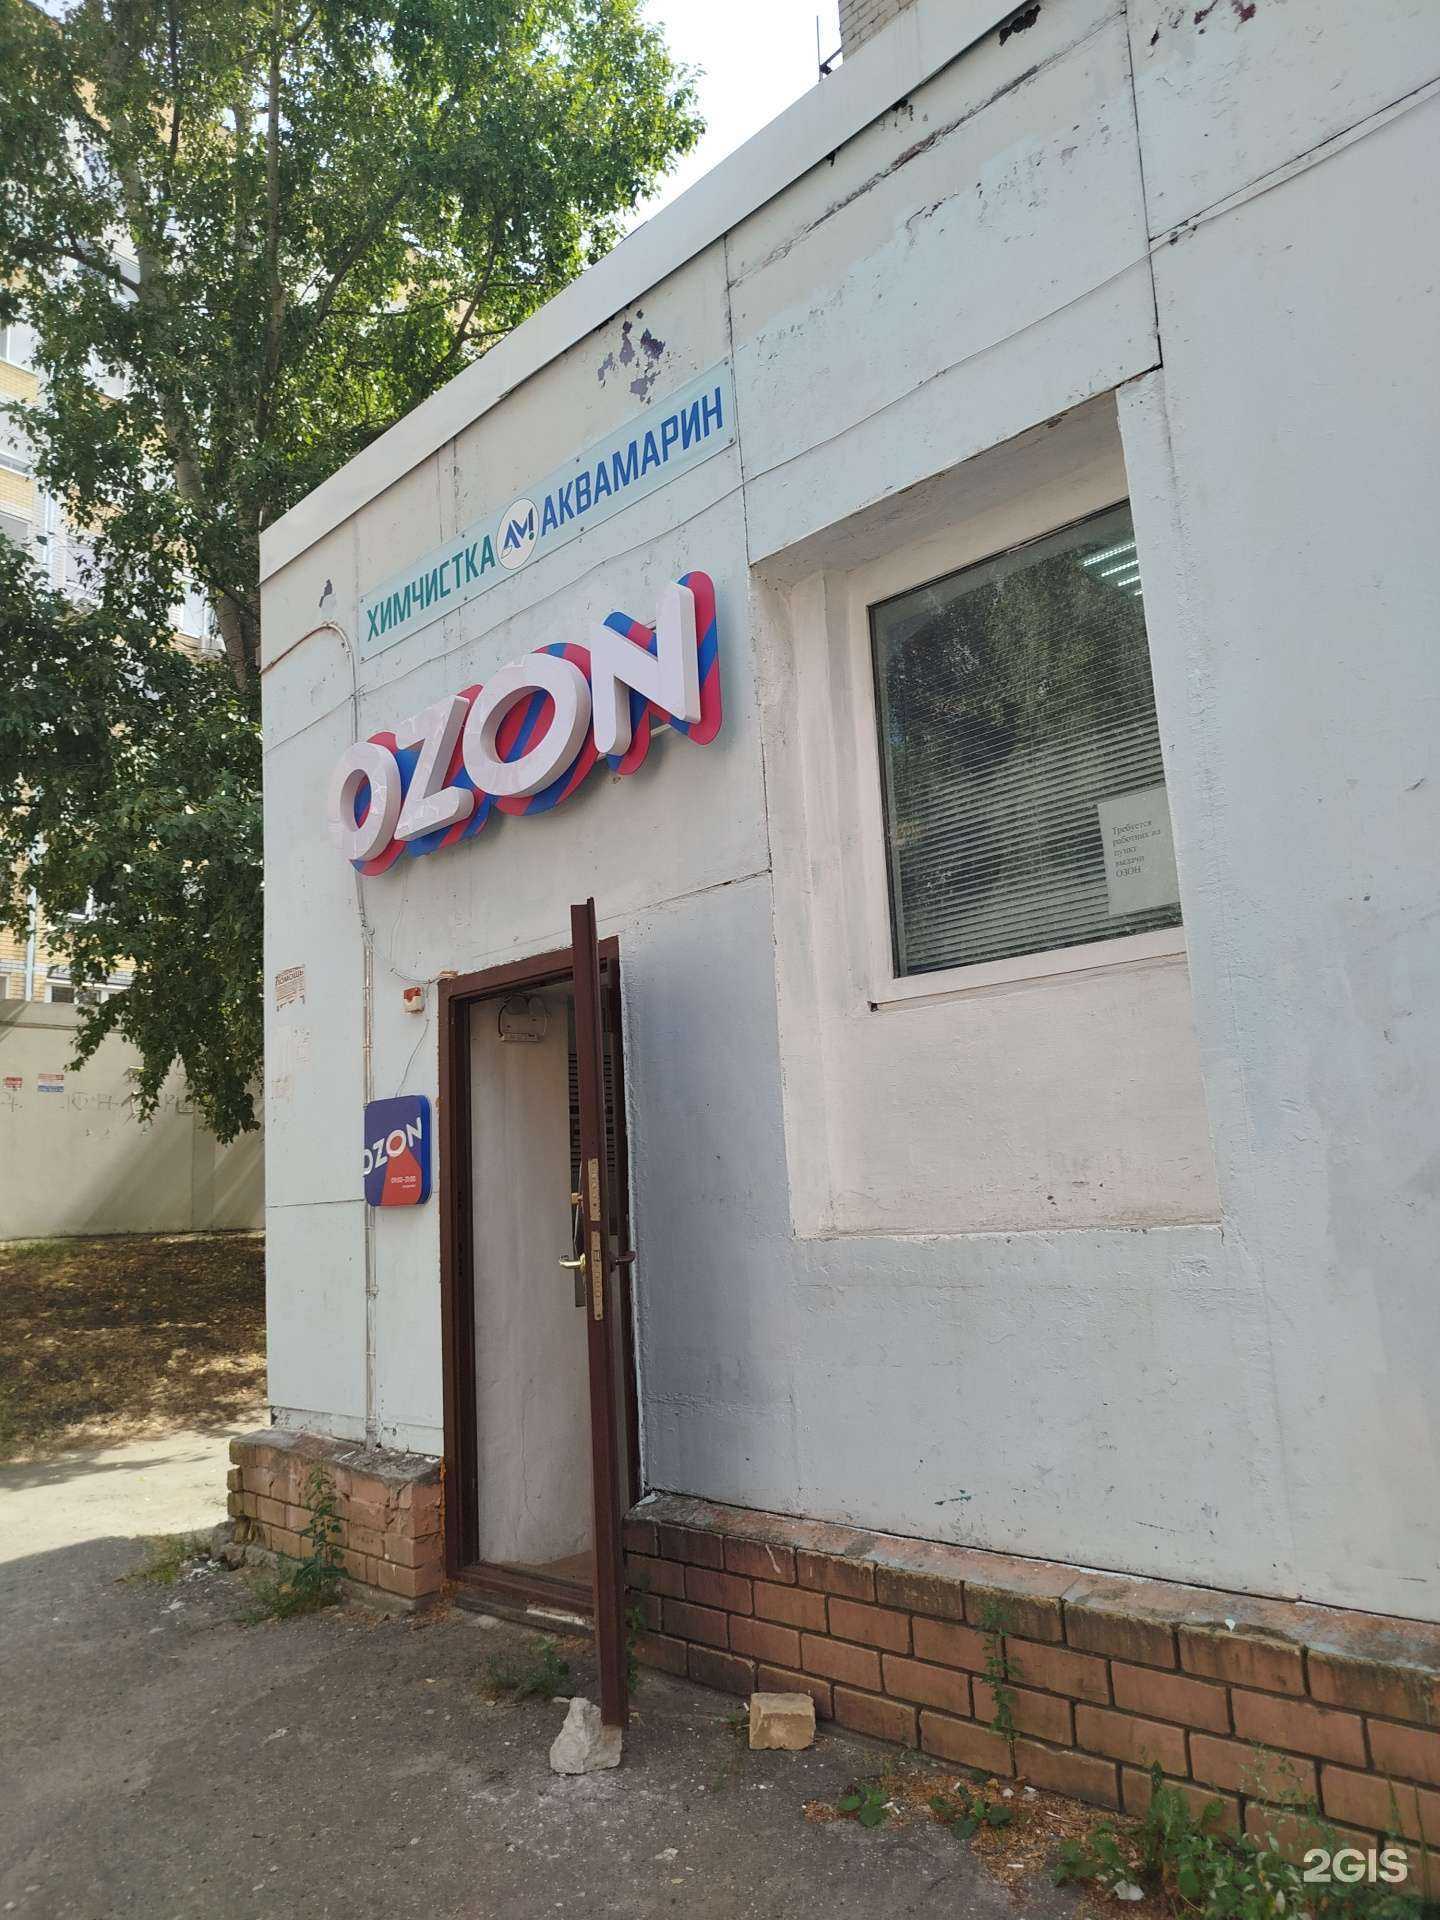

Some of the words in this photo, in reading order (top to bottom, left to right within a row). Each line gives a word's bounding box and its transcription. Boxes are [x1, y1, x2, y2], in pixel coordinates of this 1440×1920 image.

[366, 535, 496, 642] ХИМЧИСТКА
[541, 386, 723, 537] АКВАМАРИН
[329, 578, 705, 866] OZON
[1112, 820, 1152, 837] Требуется
[1115, 866, 1142, 878] ОЗОН
[363, 1117, 422, 1176] OZON
